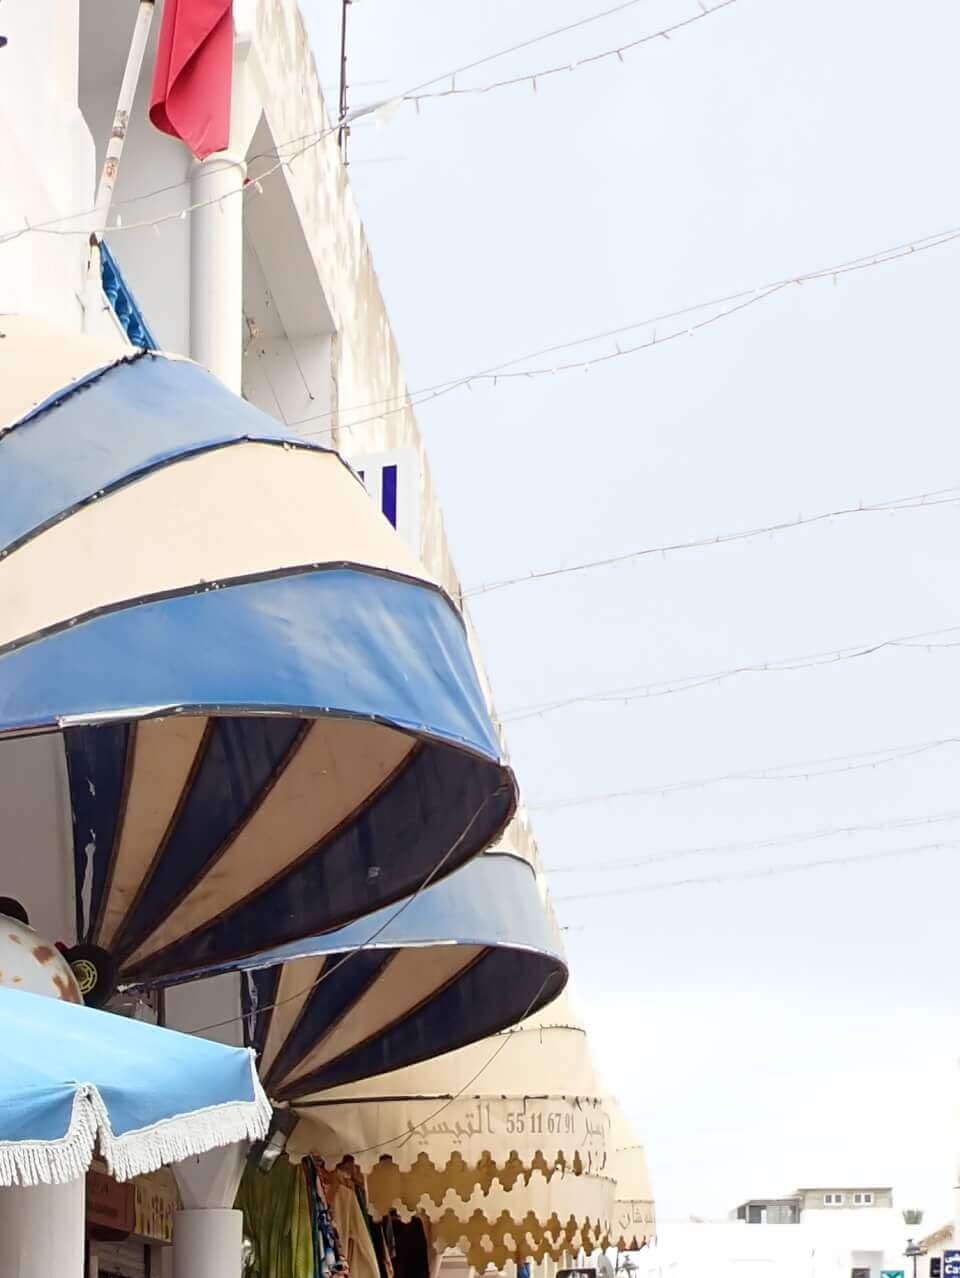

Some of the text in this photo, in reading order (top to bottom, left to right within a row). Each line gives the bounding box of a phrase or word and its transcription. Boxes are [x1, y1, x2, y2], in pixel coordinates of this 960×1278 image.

[506, 1112, 525, 1134] 55
[530, 1112, 543, 1134] 11
[547, 1112, 562, 1134] 67
